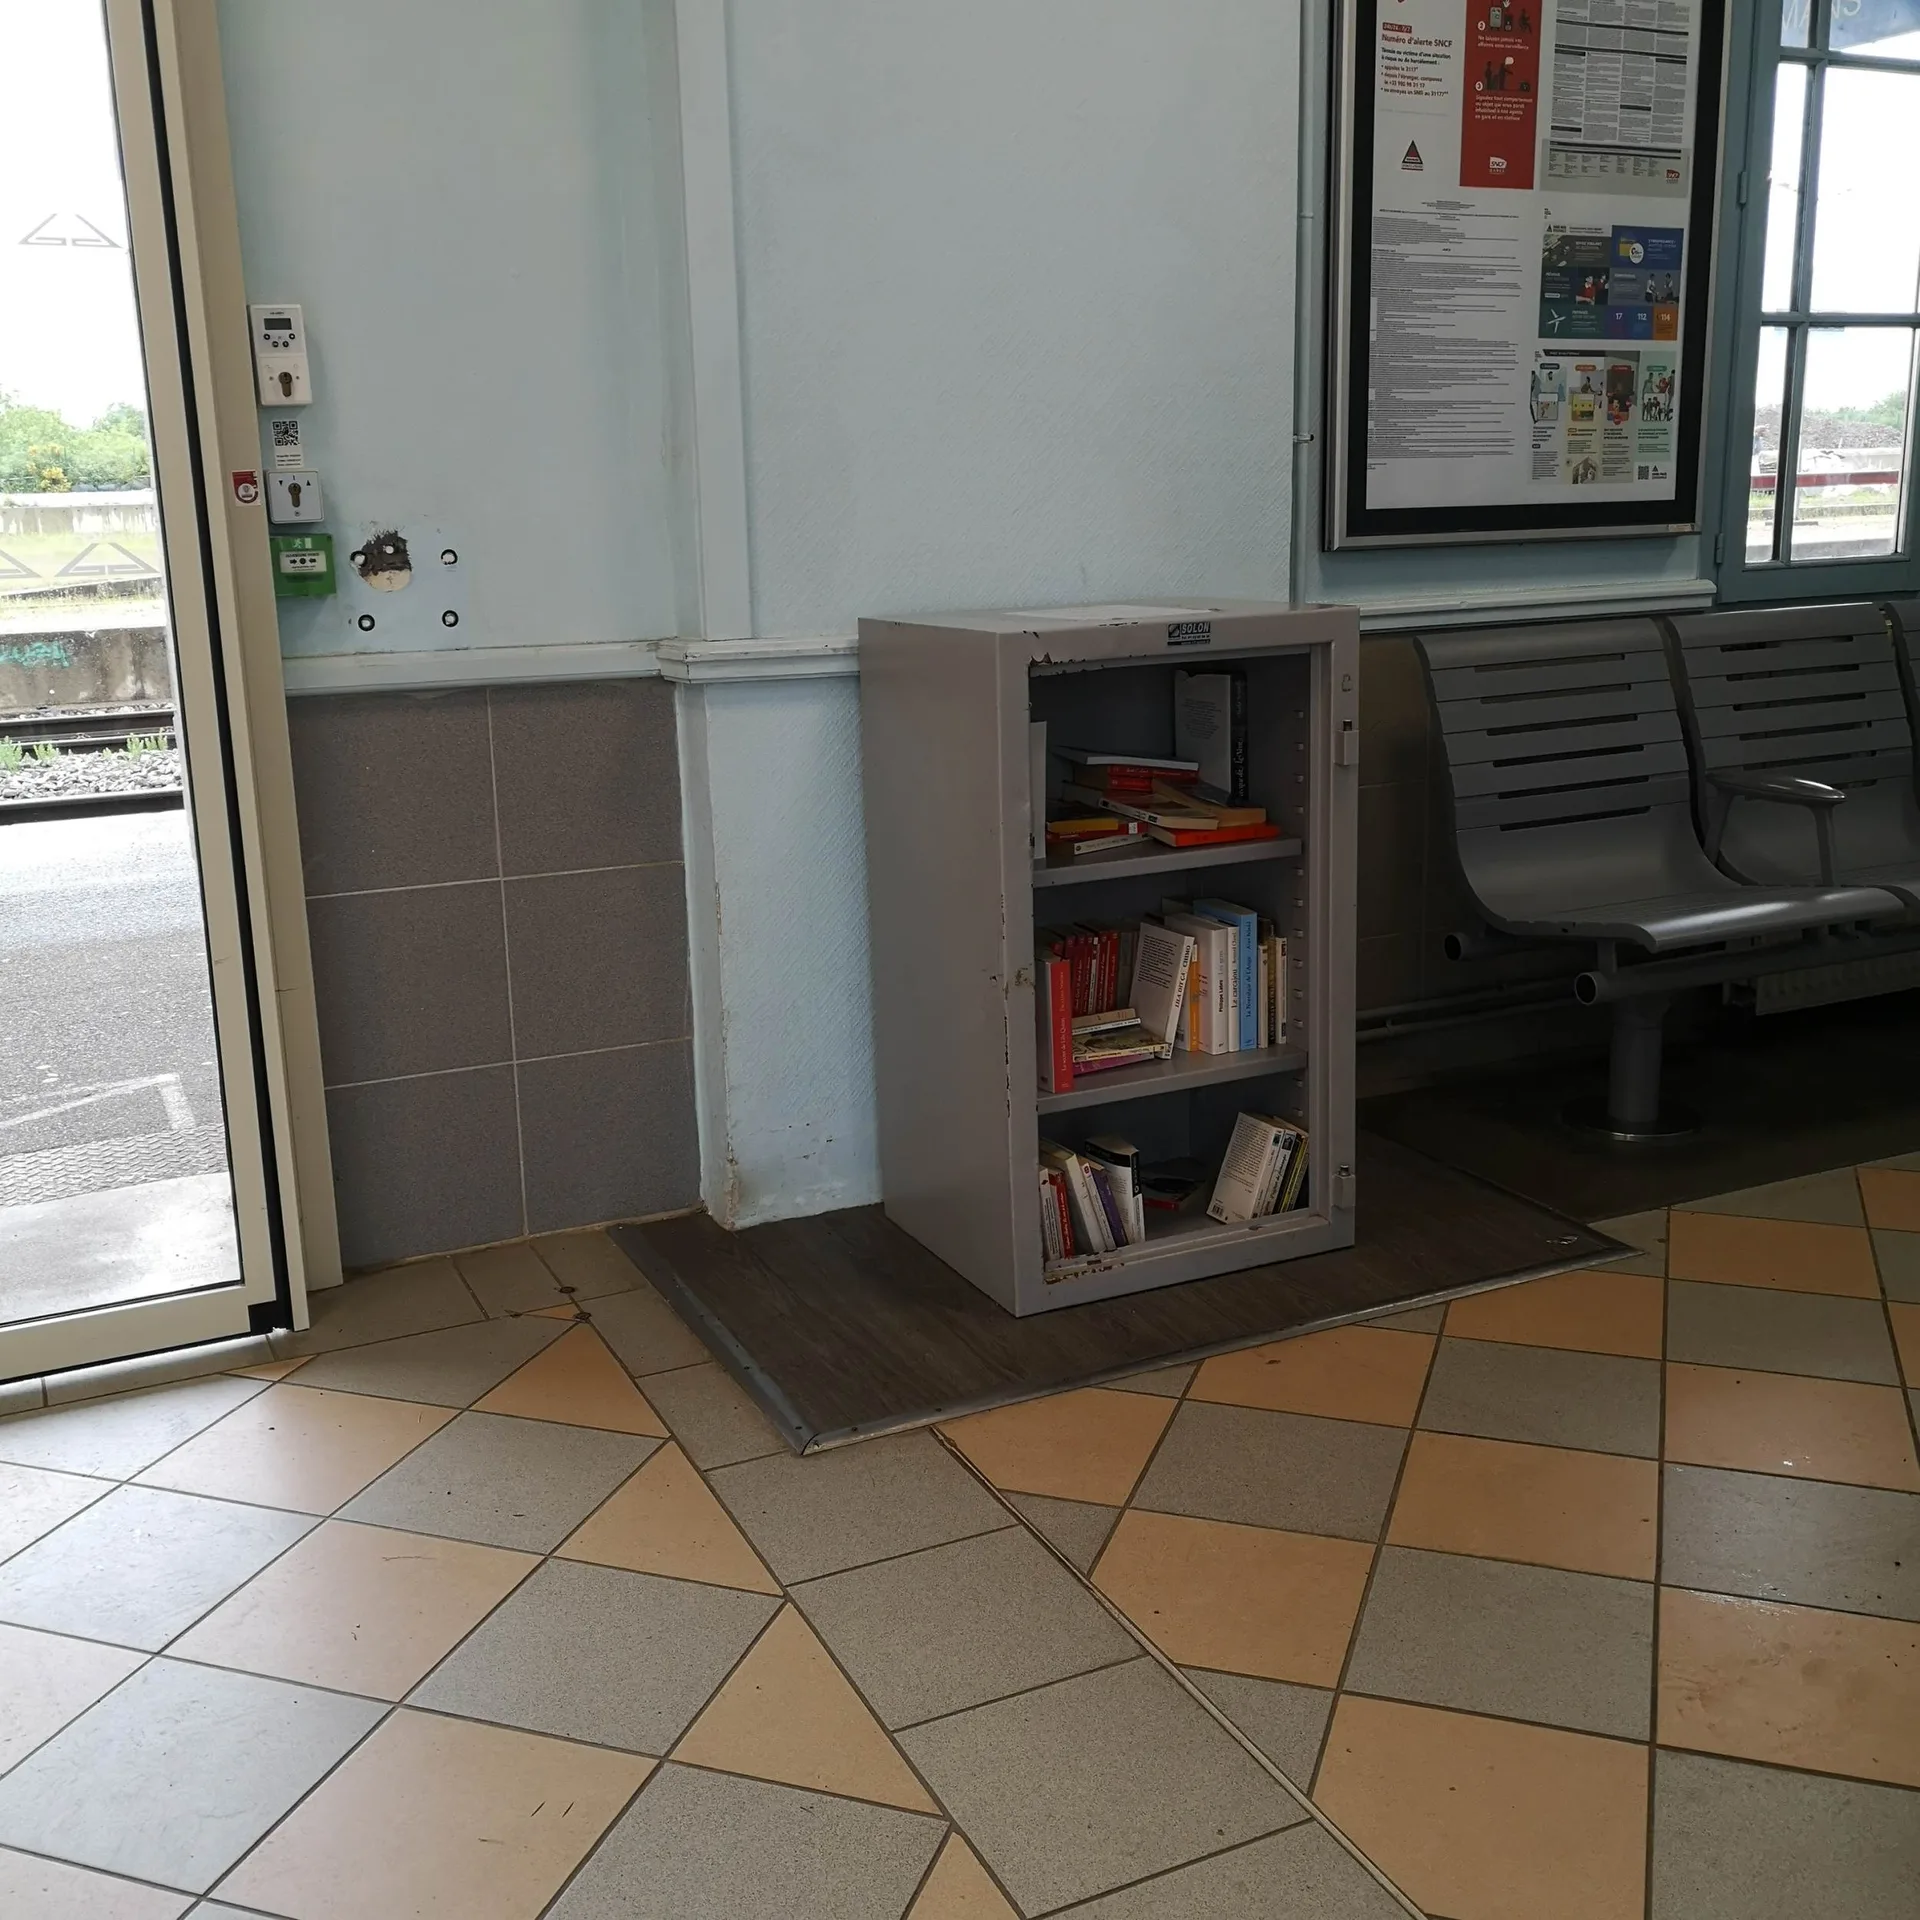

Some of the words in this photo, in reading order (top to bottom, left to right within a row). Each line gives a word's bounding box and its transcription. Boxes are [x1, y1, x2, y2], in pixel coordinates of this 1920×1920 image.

[1382, 34, 1406, 44] Numéro
[1408, 37, 1433, 46] d'alerte
[1434, 39, 1452, 47] SNCF
[1181, 622, 1209, 634] SOLON
[1230, 999, 1237, 1008] Le
